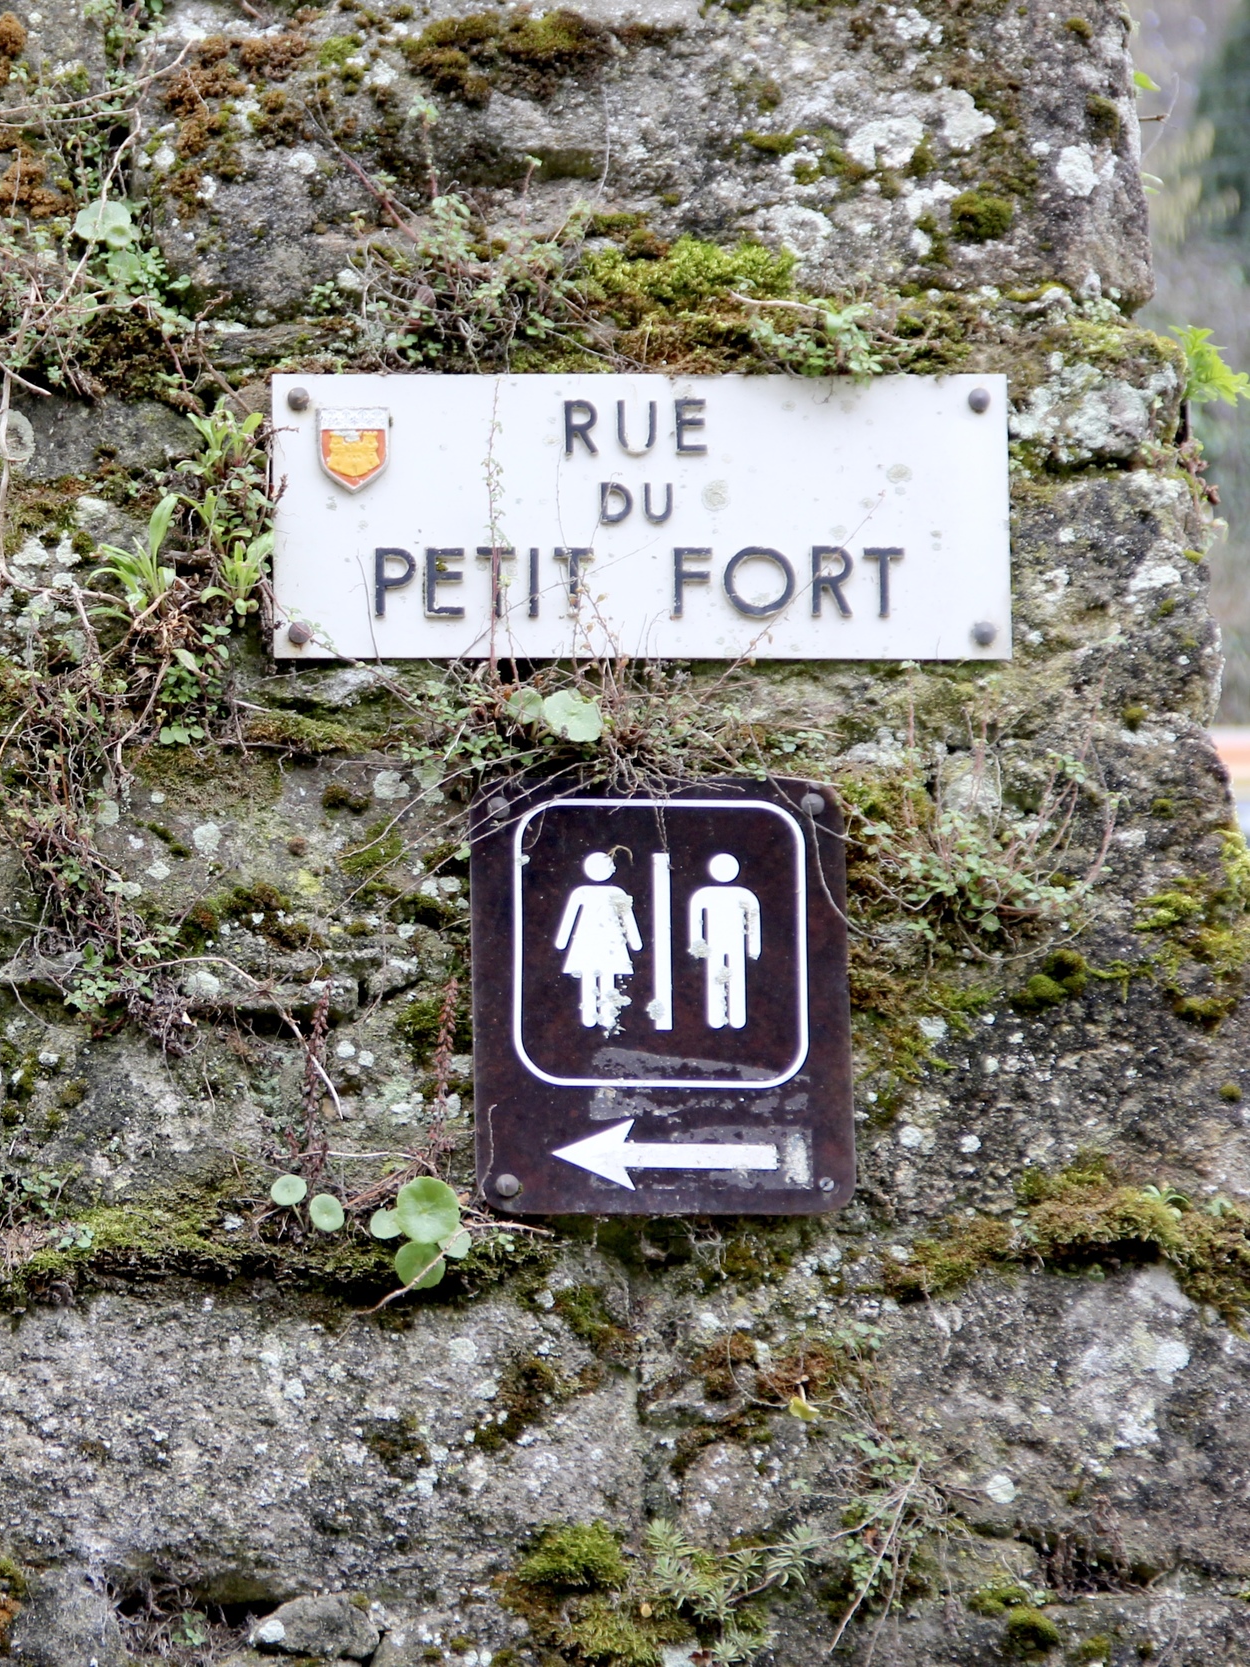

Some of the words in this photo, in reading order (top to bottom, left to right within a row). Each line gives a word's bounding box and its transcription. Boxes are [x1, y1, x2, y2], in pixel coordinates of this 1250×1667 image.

[563, 398, 707, 456] RUE
[600, 482, 673, 525] DU
[374, 546, 596, 619] PETIT
[672, 546, 905, 618] FORT
